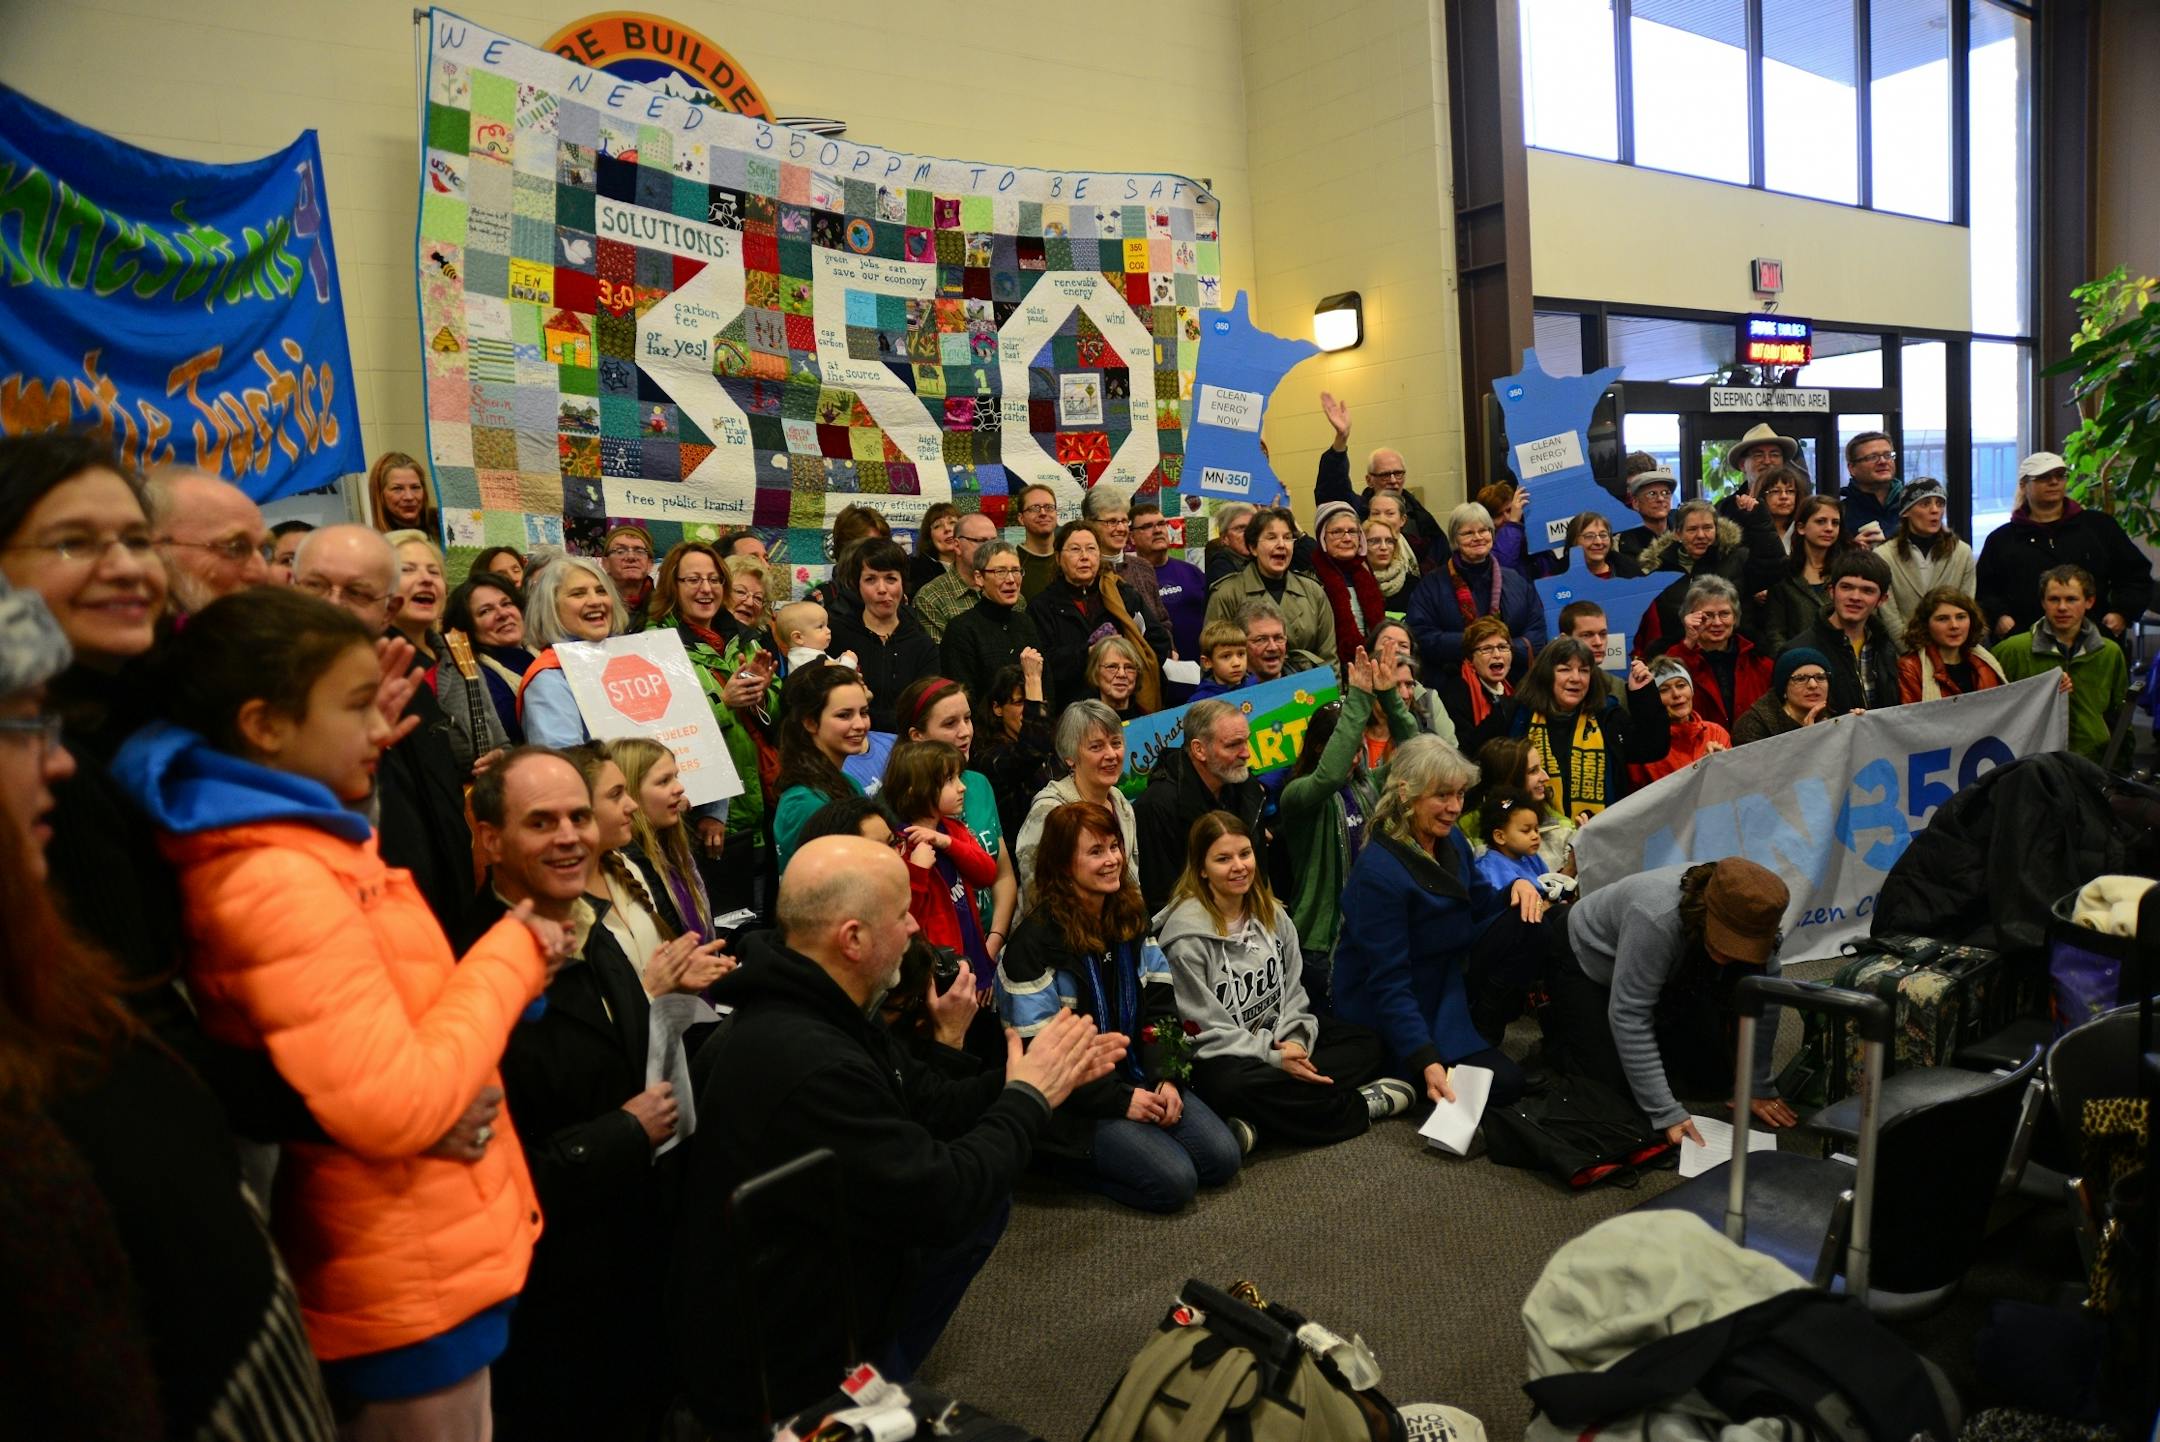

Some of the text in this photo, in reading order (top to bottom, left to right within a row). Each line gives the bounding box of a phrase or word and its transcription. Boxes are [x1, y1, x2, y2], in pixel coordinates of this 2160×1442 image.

[623, 22, 768, 122] BUILDE
[440, 23, 510, 64] WE
[568, 72, 703, 130] NEED
[970, 169, 1015, 192] TO
[1050, 177, 1090, 199] BE
[601, 207, 730, 258] SOLUTIONS:
[860, 258, 880, 270] jobs
[889, 264, 907, 274] can
[833, 267, 928, 291] save our economy
[1761, 262, 1781, 288] EXIT
[1063, 287, 1094, 300] energy
[674, 303, 720, 320] carbon
[1105, 310, 1126, 325] wind
[674, 312, 698, 328] fee
[647, 331, 662, 341] or
[647, 341, 670, 356] tax
[1216, 389, 1248, 402] CLEAN
[1713, 392, 1752, 406] SLEEPING
[1774, 394, 1806, 406] WAITING
[1808, 395, 1827, 406] AREA
[1211, 401, 1249, 415] ENERGY
[1217, 415, 1240, 426] NOW
[1531, 437, 1562, 450] CLEAN
[1530, 448, 1567, 464] ENERGY
[1540, 462, 1564, 473] NOW
[625, 491, 744, 512] free public transit
[608, 674, 662, 703] STOP
[1583, 752, 1597, 800] PACKERS
